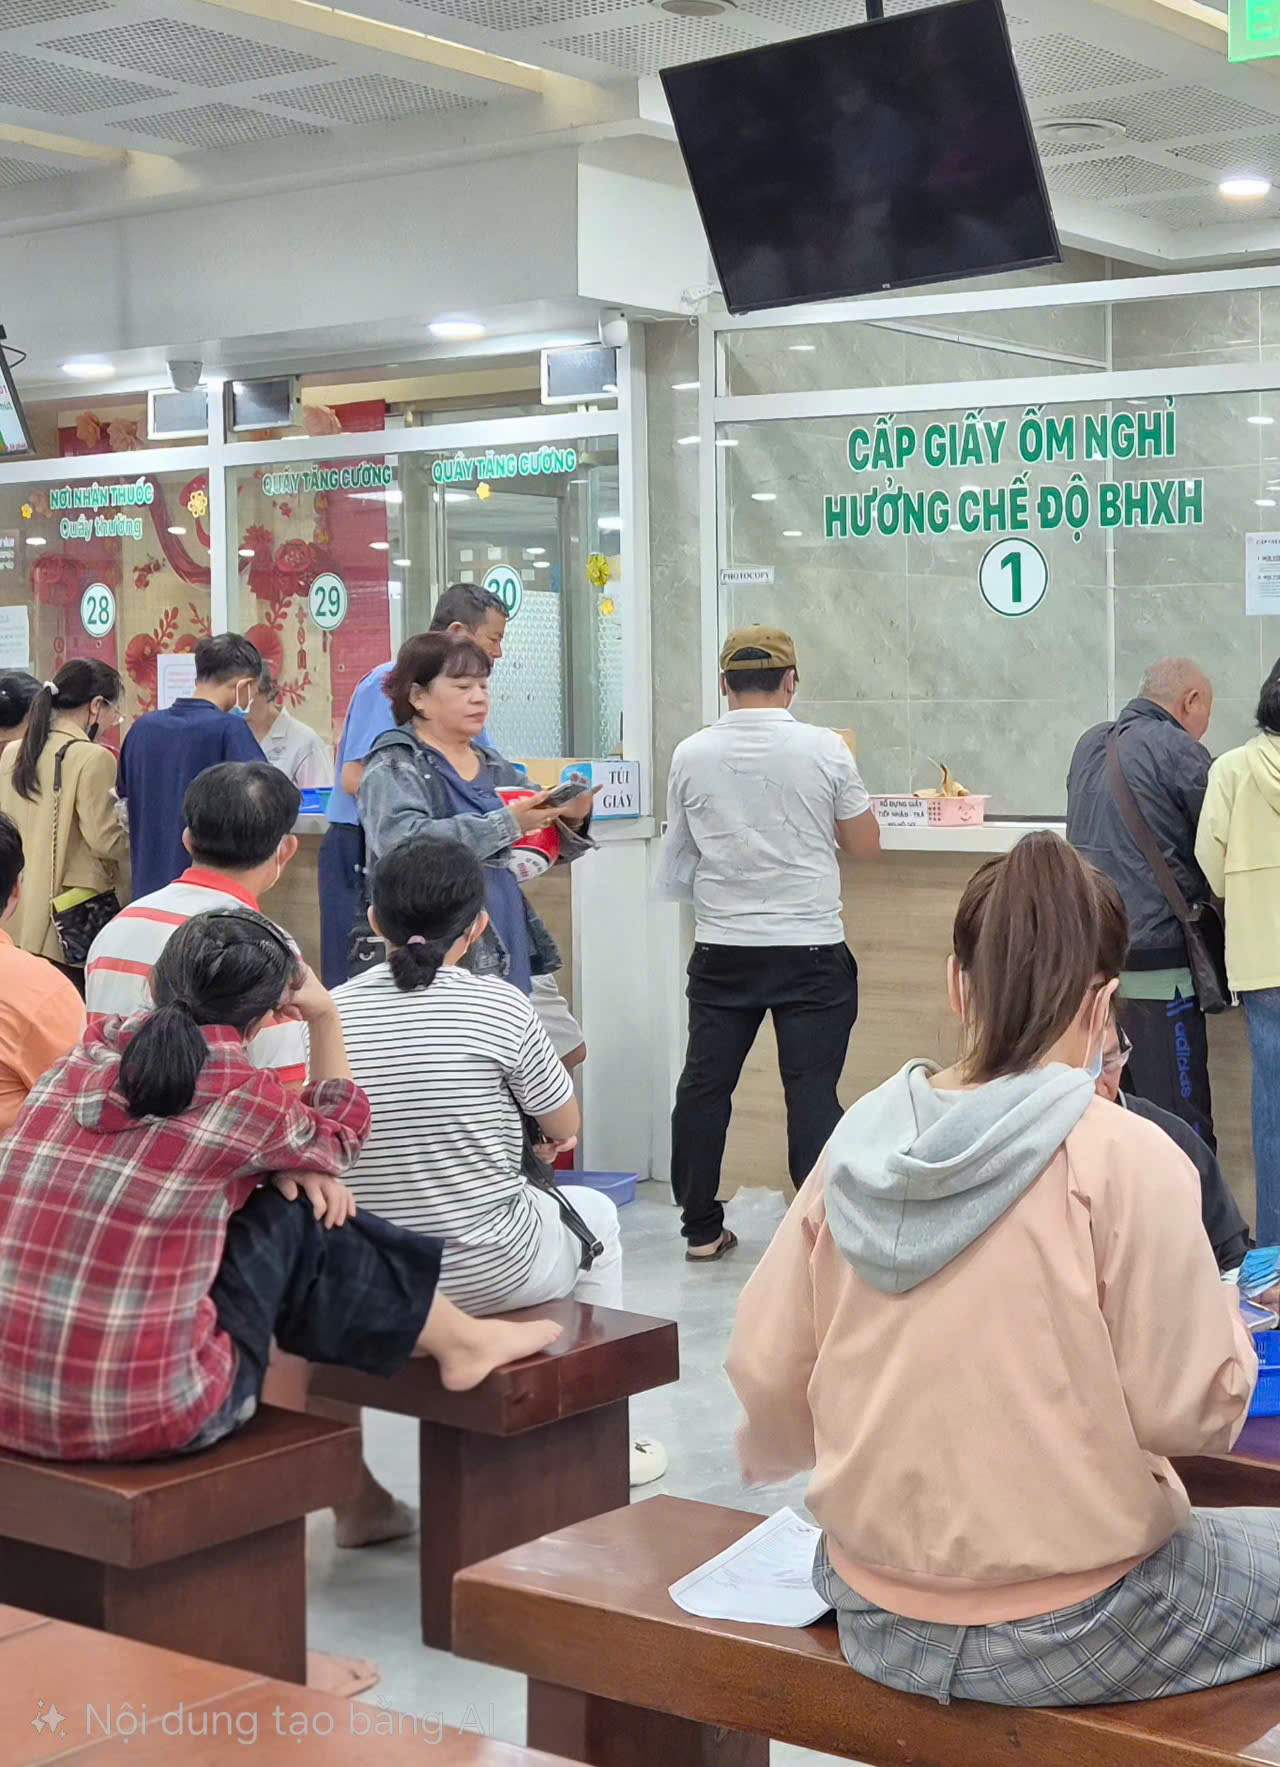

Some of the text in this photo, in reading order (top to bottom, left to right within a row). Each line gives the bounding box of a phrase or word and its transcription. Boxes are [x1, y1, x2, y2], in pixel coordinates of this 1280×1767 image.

[849, 394, 1176, 471] CẤP GIẤY ỐM NGHỈ
[302, 464, 339, 491] TĂNG
[476, 449, 517, 479] TĂNG
[73, 482, 109, 512] NHẬN
[110, 476, 155, 507] THUỐC
[825, 470, 1203, 543] HƯỞNG CHẾ ĐỘ BHXH
[722, 571, 769, 580] PHOTOCOPY
[1000, 551, 1022, 603] 1
[86, 595, 110, 625] 28
[314, 585, 341, 617] 29
[608, 766, 629, 784] TÚI
[1175, 1023, 1192, 1098] adidas
